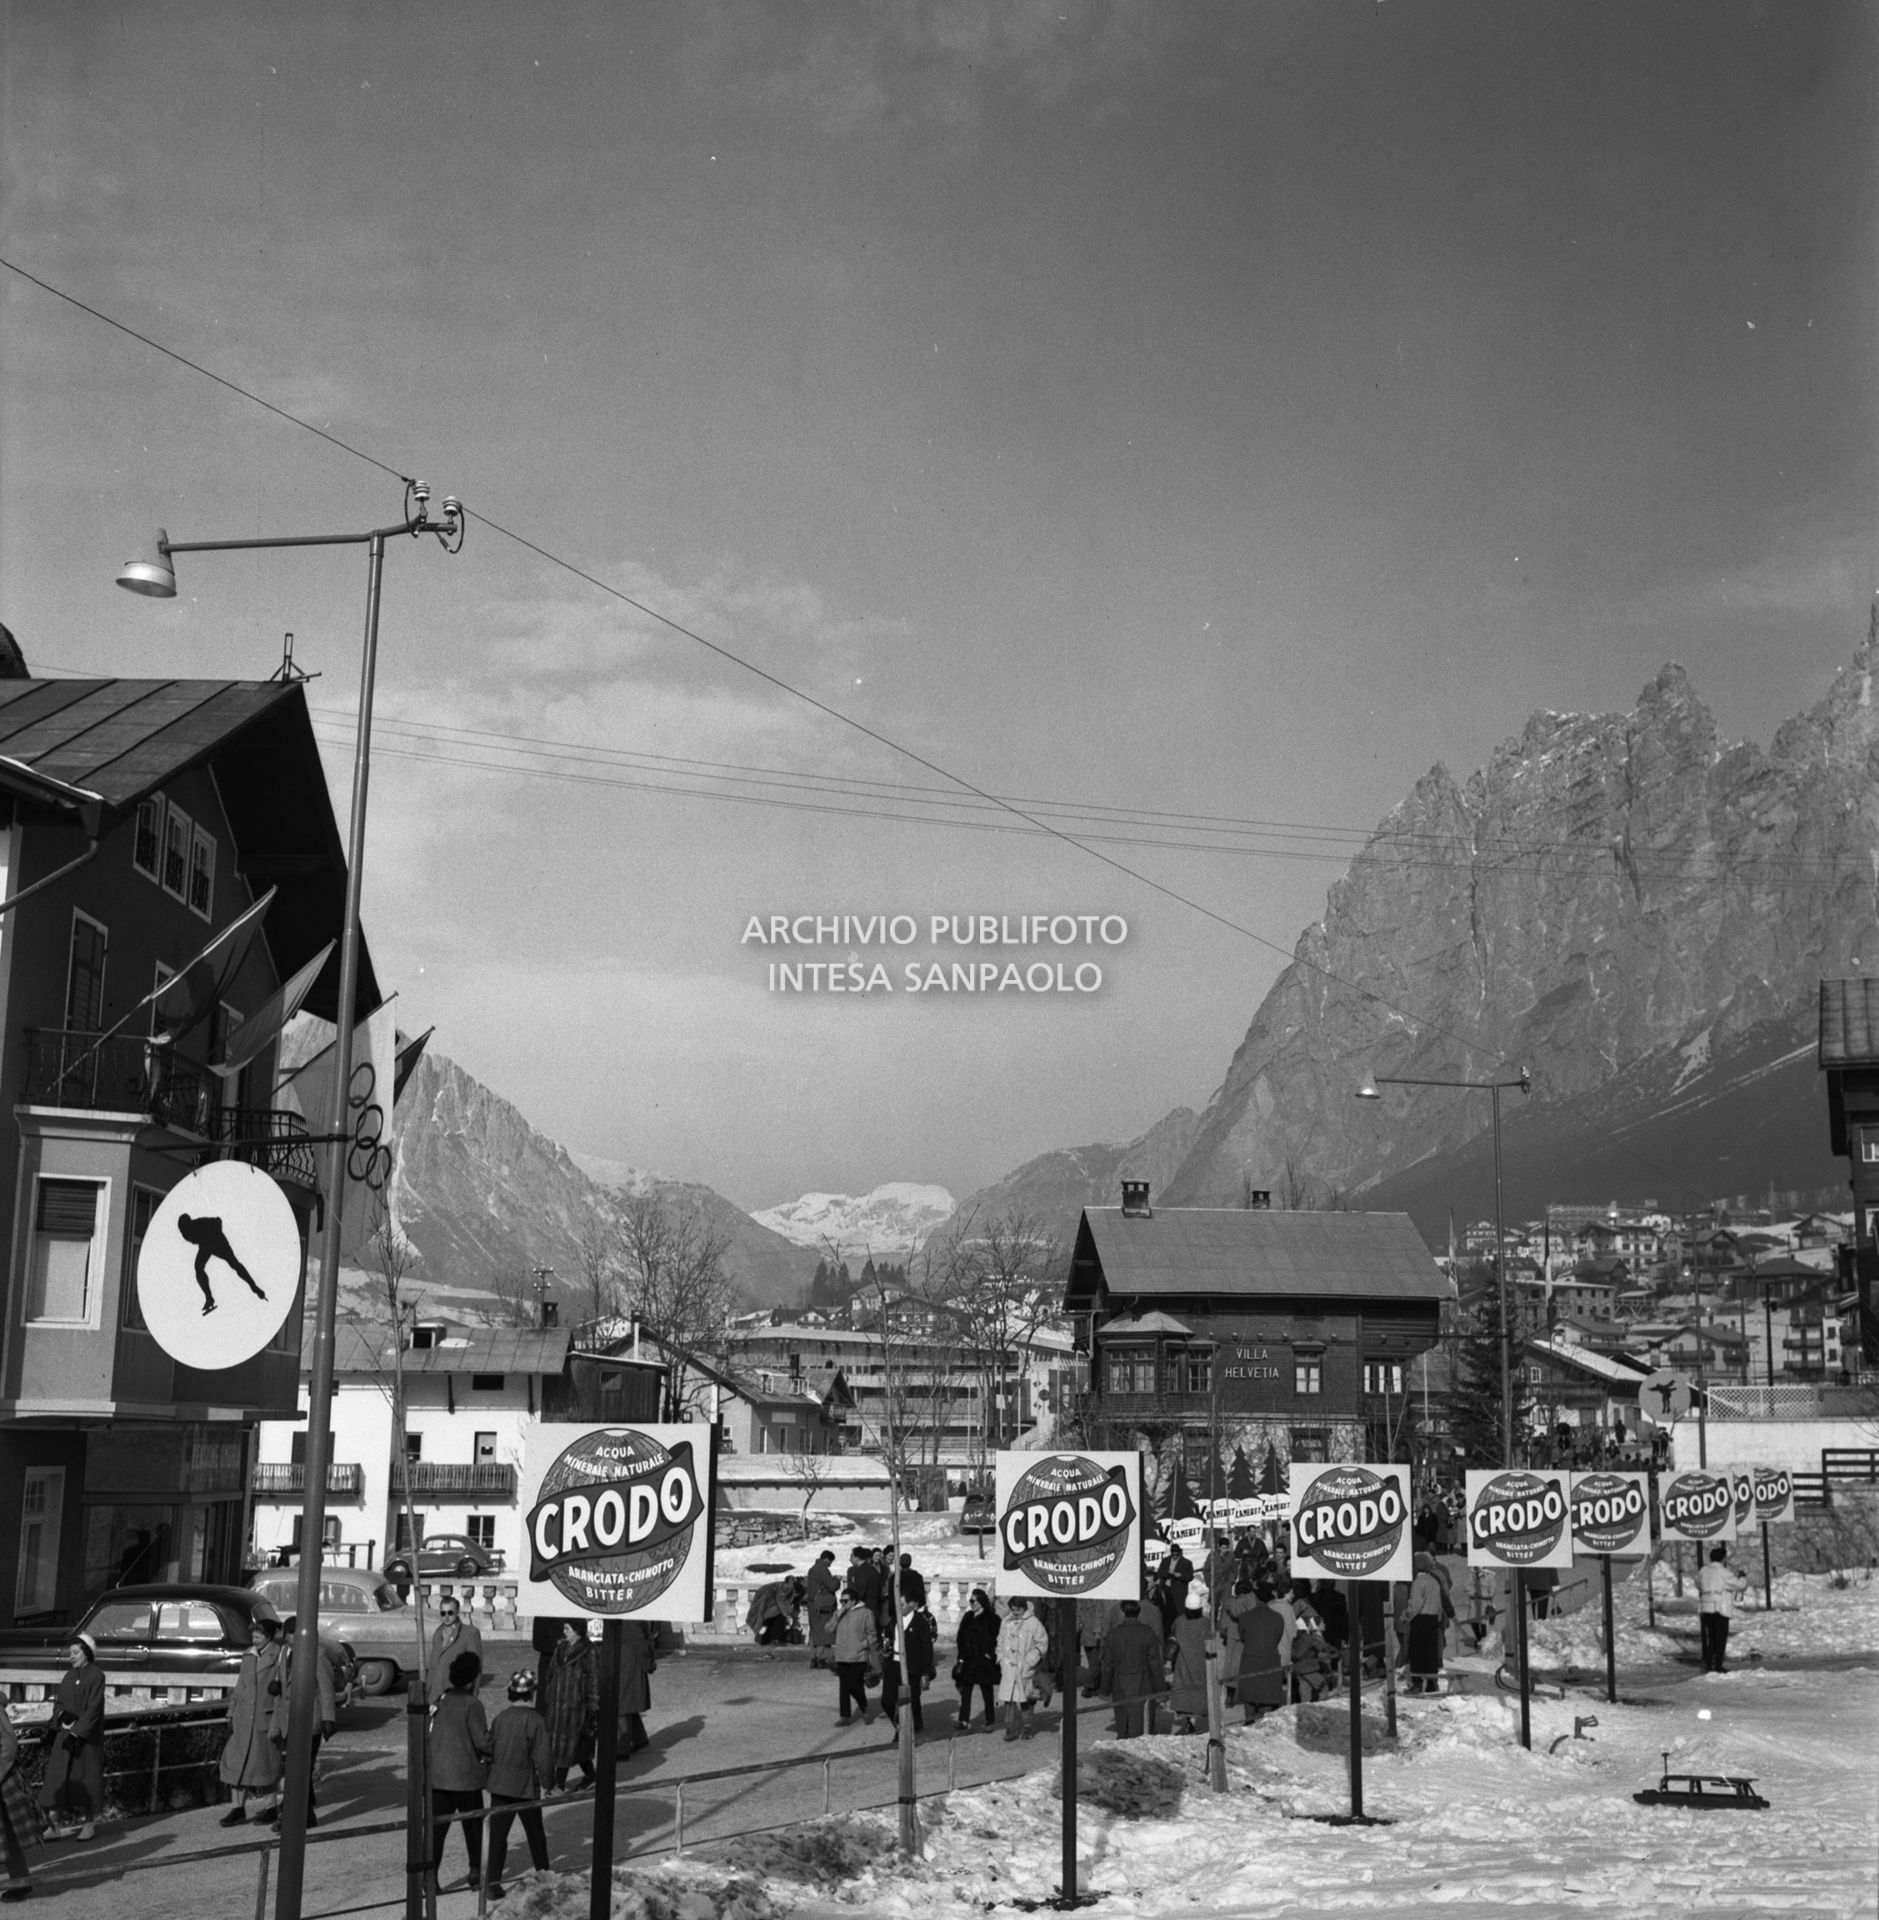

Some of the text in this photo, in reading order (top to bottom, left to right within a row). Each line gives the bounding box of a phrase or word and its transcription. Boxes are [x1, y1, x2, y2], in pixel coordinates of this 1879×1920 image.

[1236, 1348, 1268, 1360] VILLA
[1225, 1367, 1279, 1378] HELVETIA
[595, 1446, 635, 1459] ACQUA
[563, 1453, 665, 1478] MINERALE NATURALE
[1050, 1468, 1081, 1479] ACQUA
[1026, 1474, 1104, 1492] MINERALE NATURALE
[1335, 1477, 1362, 1485] ACQUA
[1756, 1478, 1788, 1501] ODO
[1665, 1486, 1729, 1520] CRODO
[535, 1466, 693, 1561] CRODO
[1006, 1484, 1127, 1553] CRODO
[1299, 1489, 1400, 1545] CRODO
[1474, 1491, 1562, 1538] CRODO
[1048, 1573, 1085, 1585] BITTER
[585, 1586, 633, 1601] BITTER
